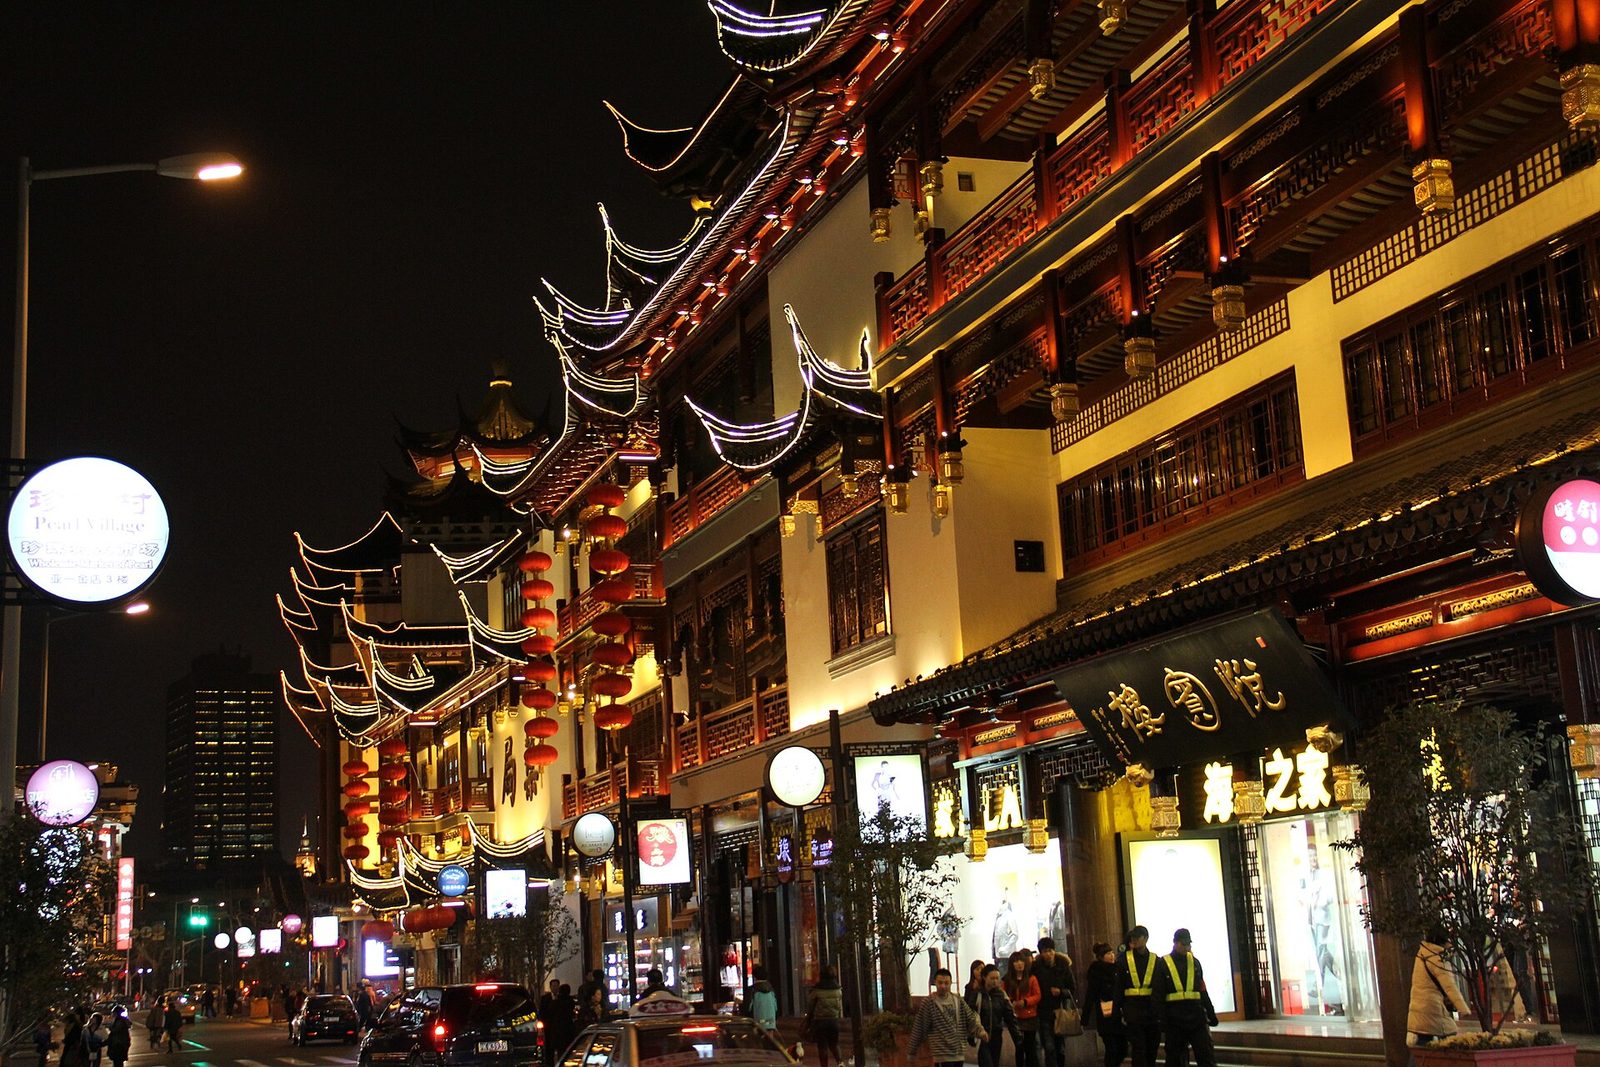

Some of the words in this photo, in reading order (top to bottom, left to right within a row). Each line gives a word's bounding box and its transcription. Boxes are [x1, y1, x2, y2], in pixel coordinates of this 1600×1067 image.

[35, 516, 80, 530] Pearl
[86, 517, 145, 535] Village
[1203, 743, 1331, 824] 海之家
